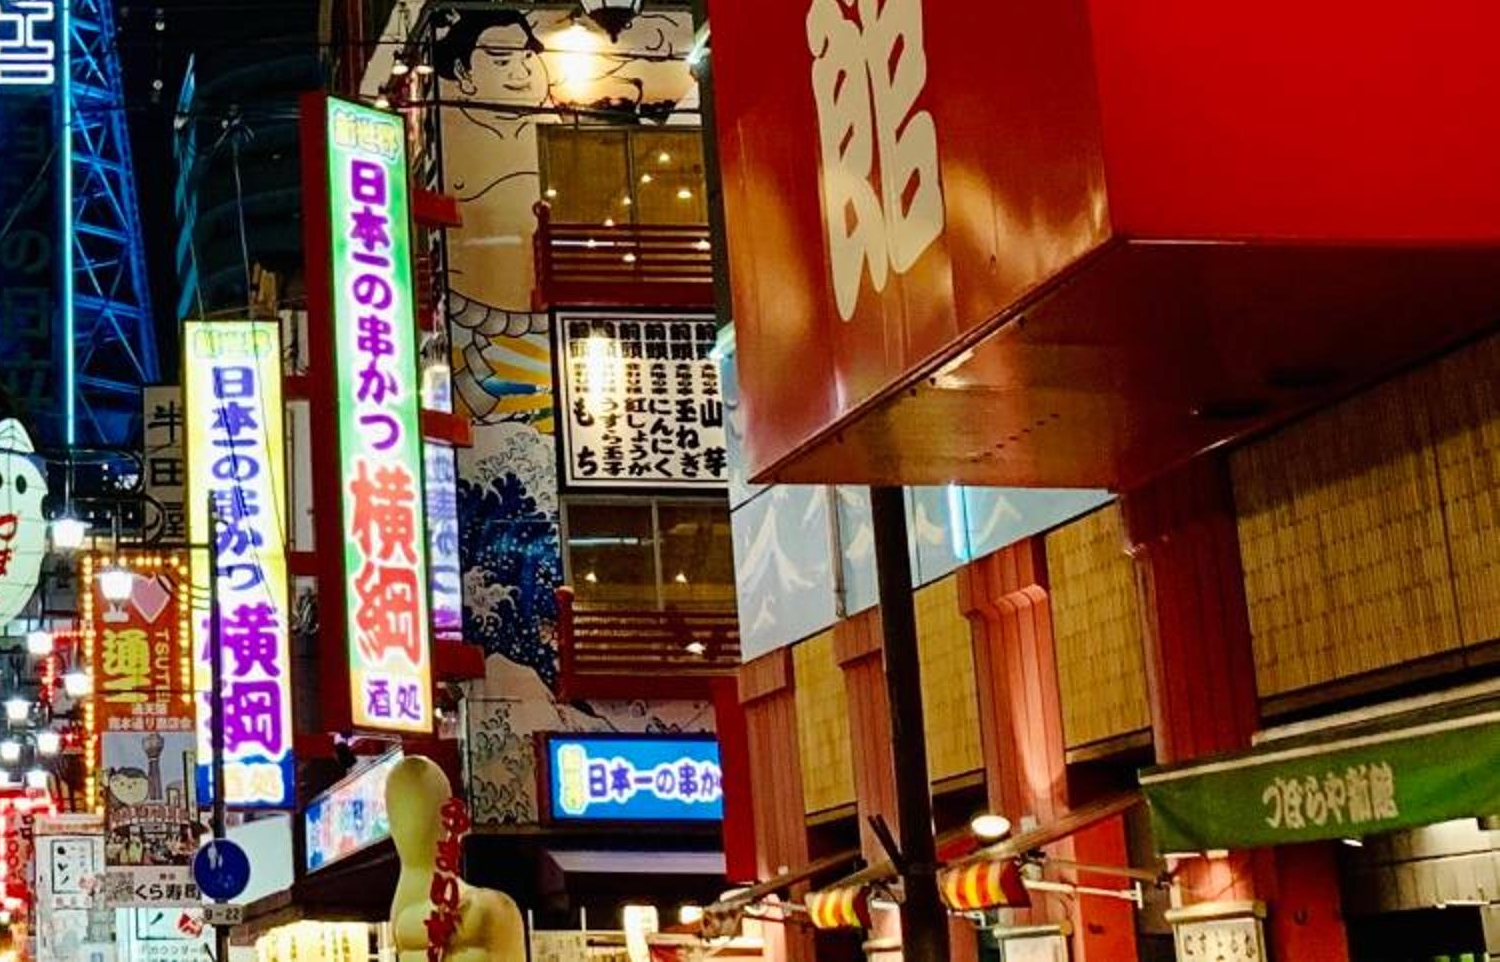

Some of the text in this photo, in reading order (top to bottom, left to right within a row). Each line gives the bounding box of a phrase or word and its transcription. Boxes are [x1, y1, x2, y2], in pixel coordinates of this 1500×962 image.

[350, 160, 401, 451] 日本一の串かつ
[573, 398, 598, 476] もち
[625, 398, 651, 476] 紅しょうが
[649, 398, 675, 477] にんにく
[675, 399, 700, 477] 玉ねぎ
[701, 399, 727, 477] 山芋
[211, 366, 265, 591] 日本一の串かつ
[350, 459, 420, 665] 横綱
[201, 602, 282, 755] 横綱
[367, 679, 422, 721] 酒処
[589, 763, 722, 797] 日本一の串か
[135, 883, 201, 900] くら寿司
